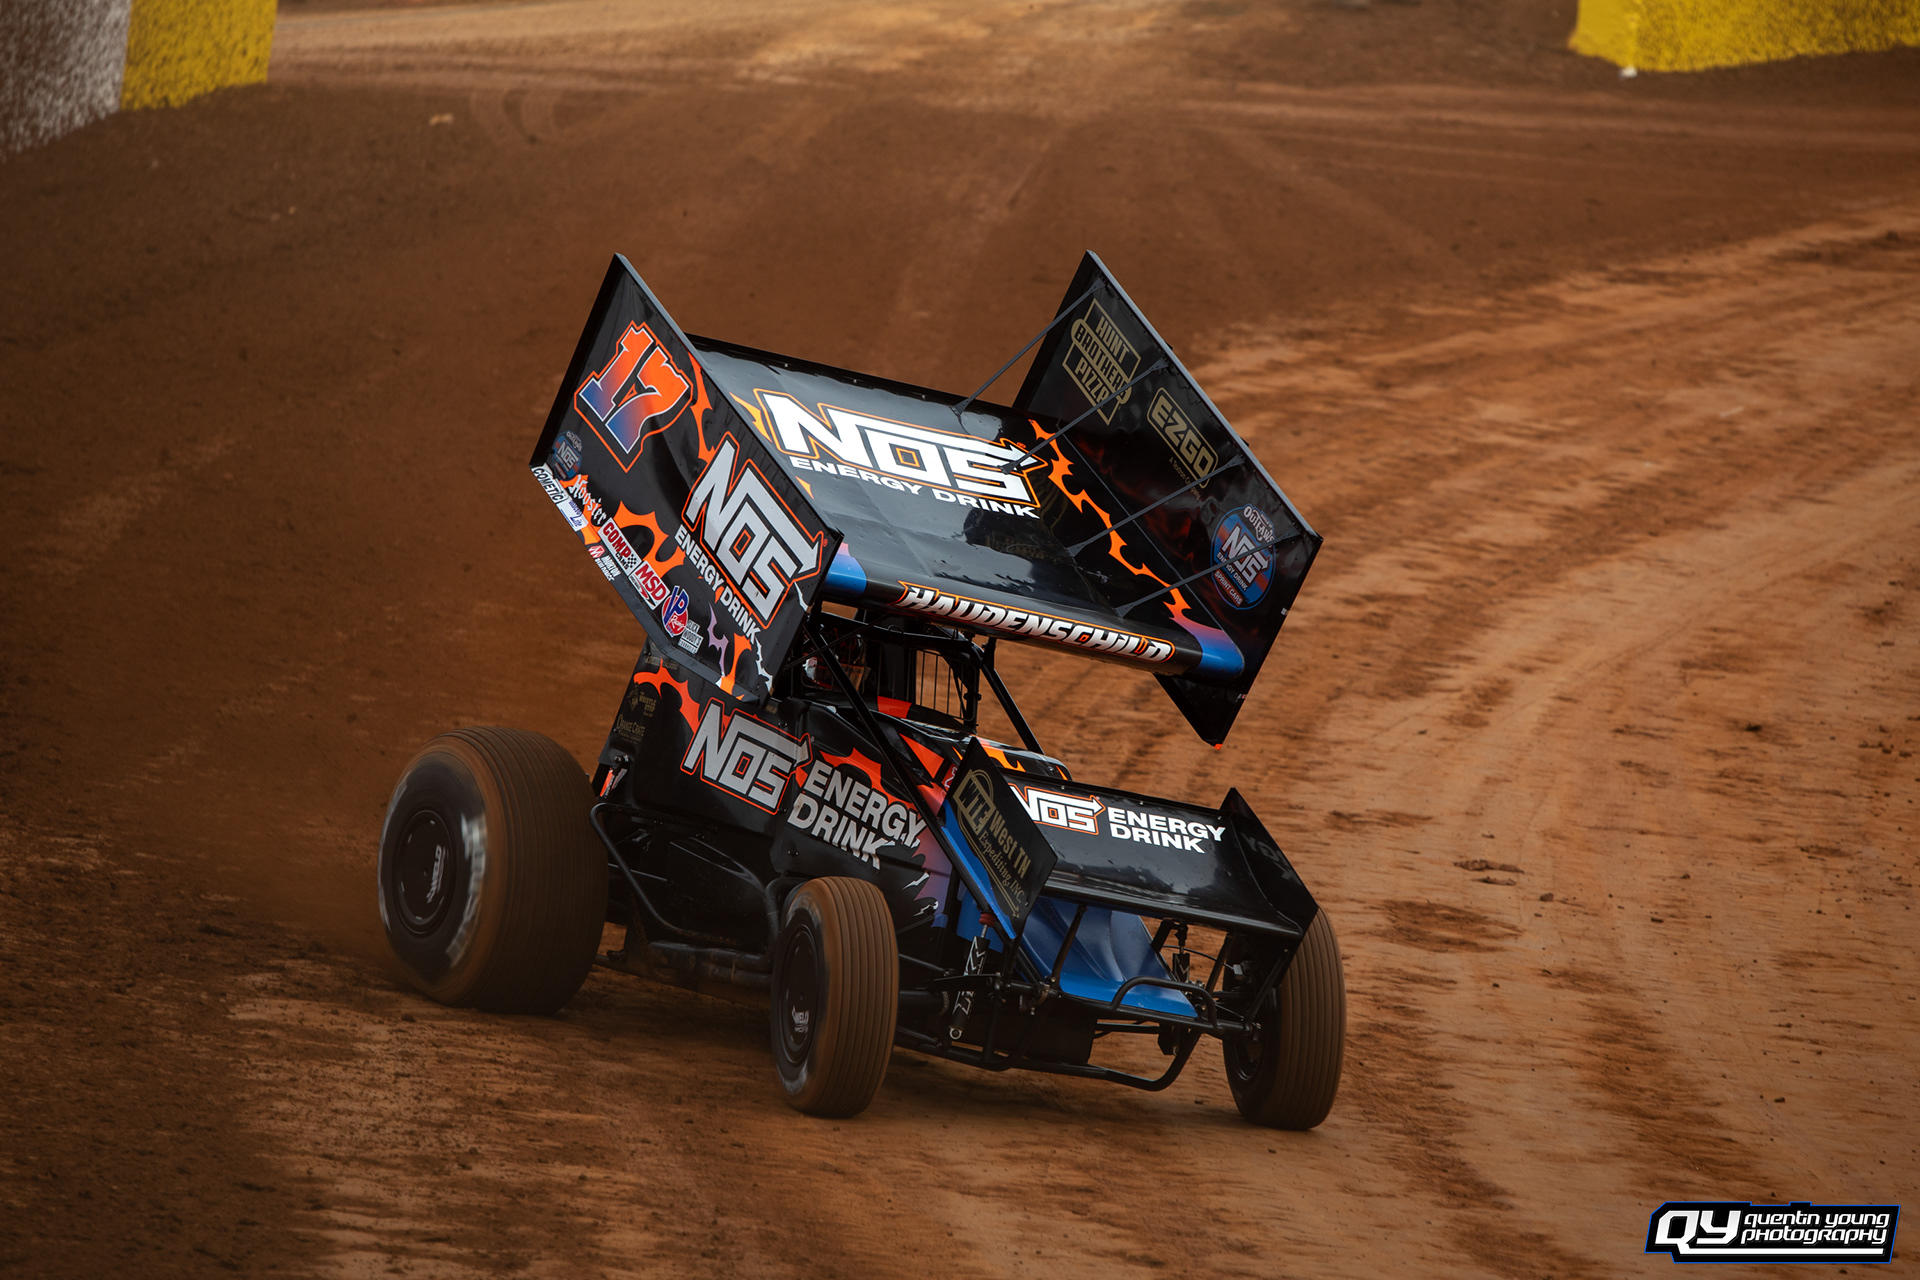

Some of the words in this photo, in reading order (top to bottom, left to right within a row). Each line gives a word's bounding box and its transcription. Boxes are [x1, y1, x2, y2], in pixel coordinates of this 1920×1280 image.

[1074, 322, 1131, 402] BROTHERS
[1095, 316, 1130, 363] HUNT
[579, 326, 690, 454] 17
[1074, 357, 1110, 402] PIZZA
[558, 441, 580, 470] NOS
[762, 393, 1038, 502] NOS
[1150, 395, 1215, 480] EZGO
[533, 468, 564, 501] COMETIC
[568, 474, 607, 525] Hoosier
[788, 456, 923, 496] ENERGY
[932, 487, 1040, 519] DRINK
[603, 522, 632, 558] COMP
[685, 440, 819, 621] NOS
[1221, 525, 1269, 584] NOS
[615, 551, 629, 570] CAMS
[635, 564, 667, 600] MSD
[675, 524, 724, 591] ENERGY
[720, 586, 761, 641] DRINK
[1233, 571, 1249, 591] DRINK
[663, 586, 689, 626] VP
[1214, 570, 1232, 591] SPRINT
[1229, 588, 1243, 605] CARS
[900, 585, 1174, 662] HAUDENSCHILD
[684, 703, 808, 809] NOS
[804, 760, 928, 848] ENERGY
[958, 777, 992, 829] WTE
[1010, 785, 1105, 833] NOS
[1107, 806, 1226, 842] ENERGY
[788, 794, 896, 870] DRINK
[989, 809, 1019, 860] West
[1013, 846, 1031, 879] TN
[1109, 823, 1205, 854] DRINK
[1009, 879, 1026, 903] INC.
